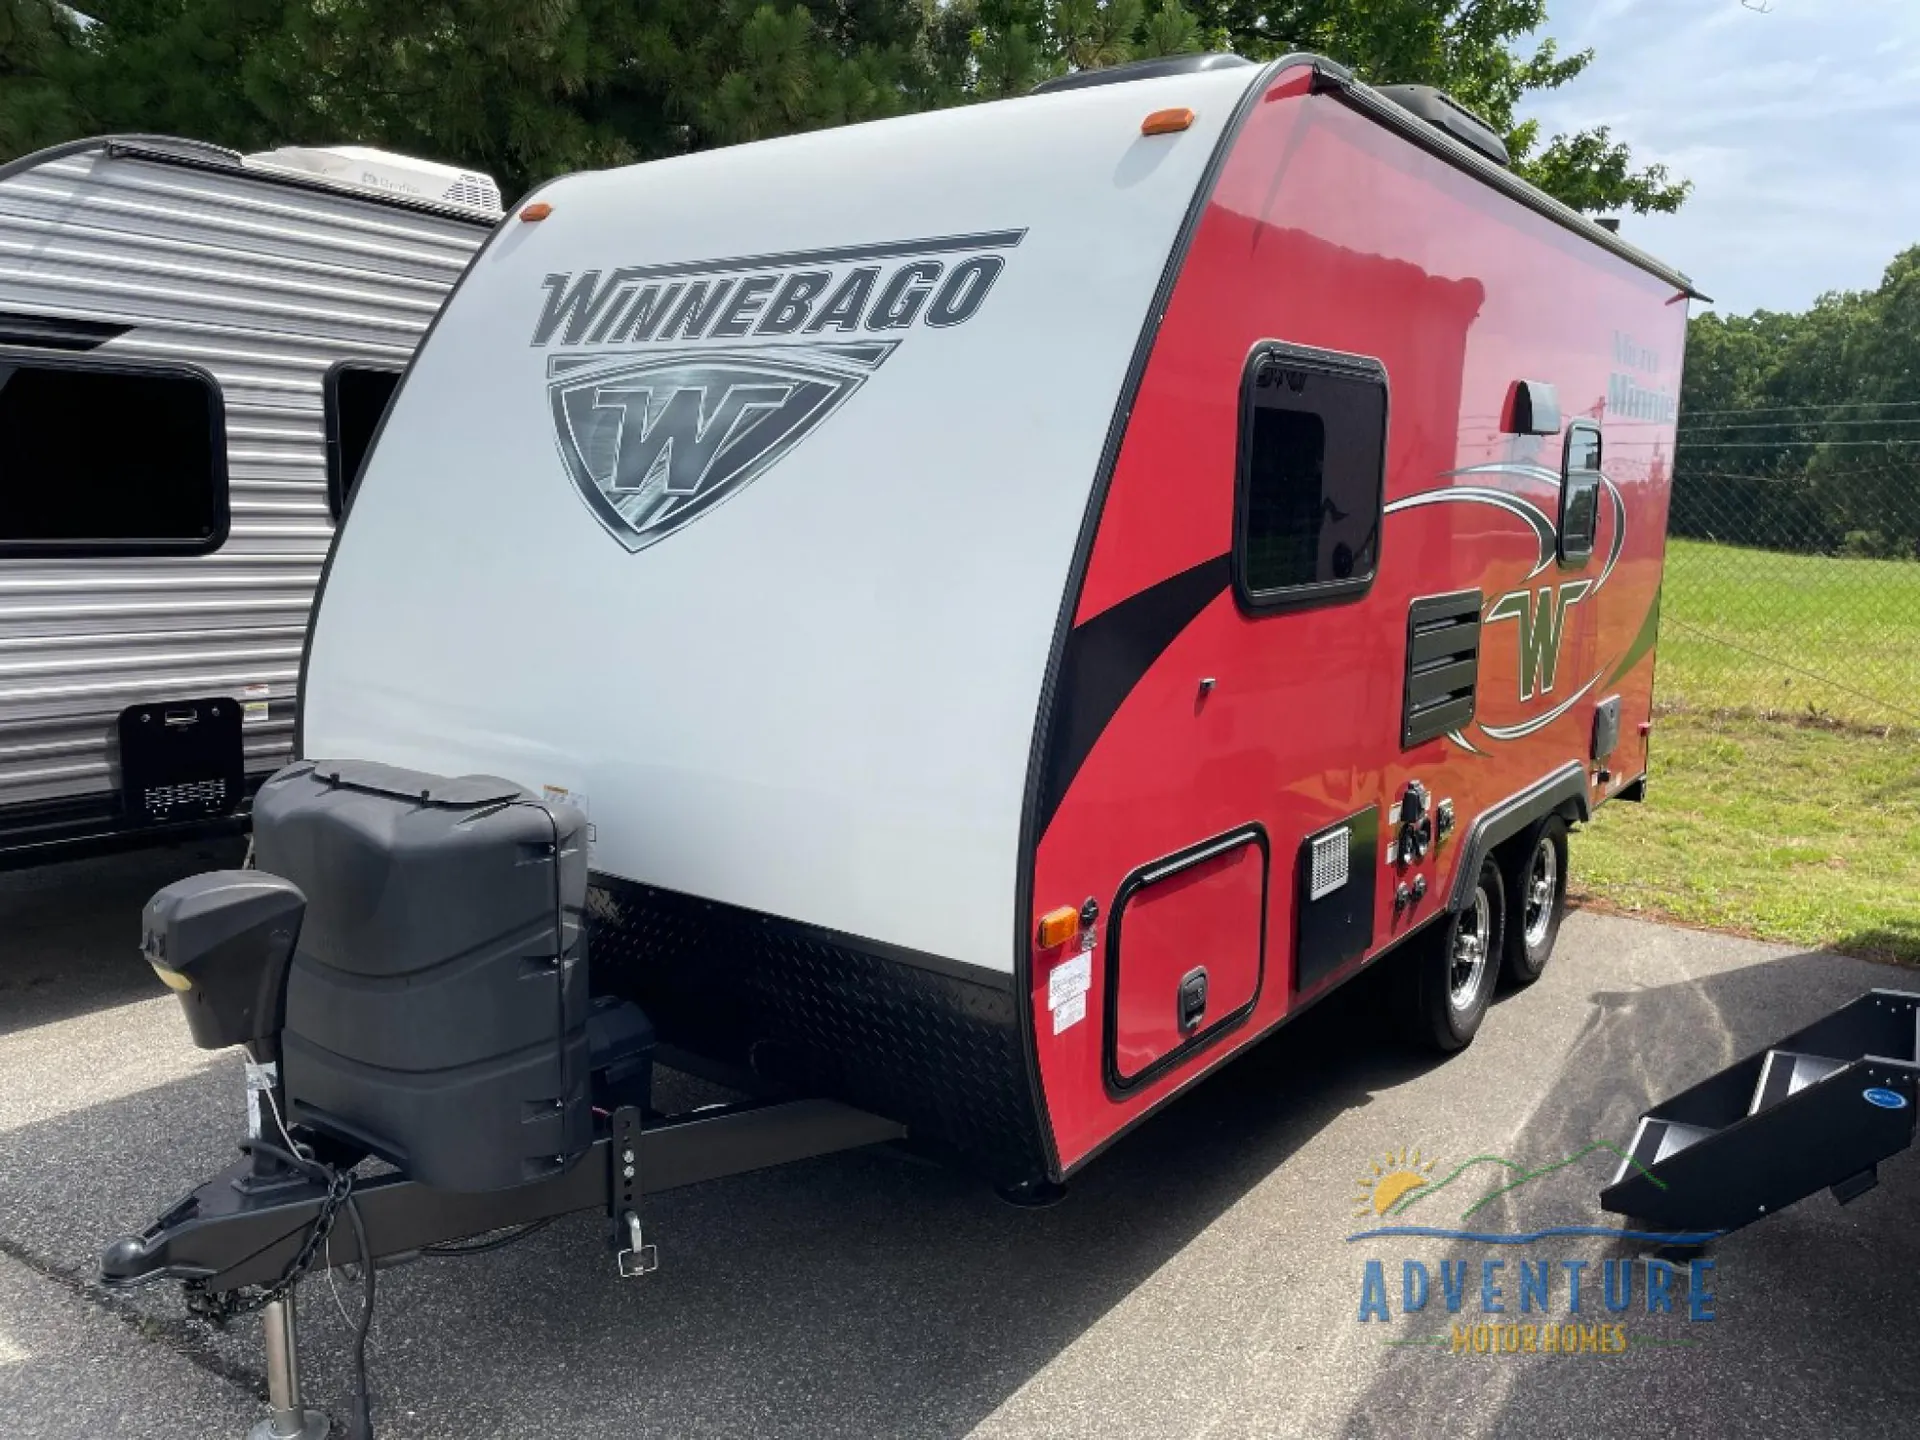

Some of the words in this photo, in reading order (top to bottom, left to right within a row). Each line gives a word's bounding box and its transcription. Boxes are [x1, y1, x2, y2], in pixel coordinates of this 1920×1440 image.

[530, 255, 1006, 347] WINNEBAGO
[594, 383, 795, 495] W
[1484, 579, 1594, 702] W
